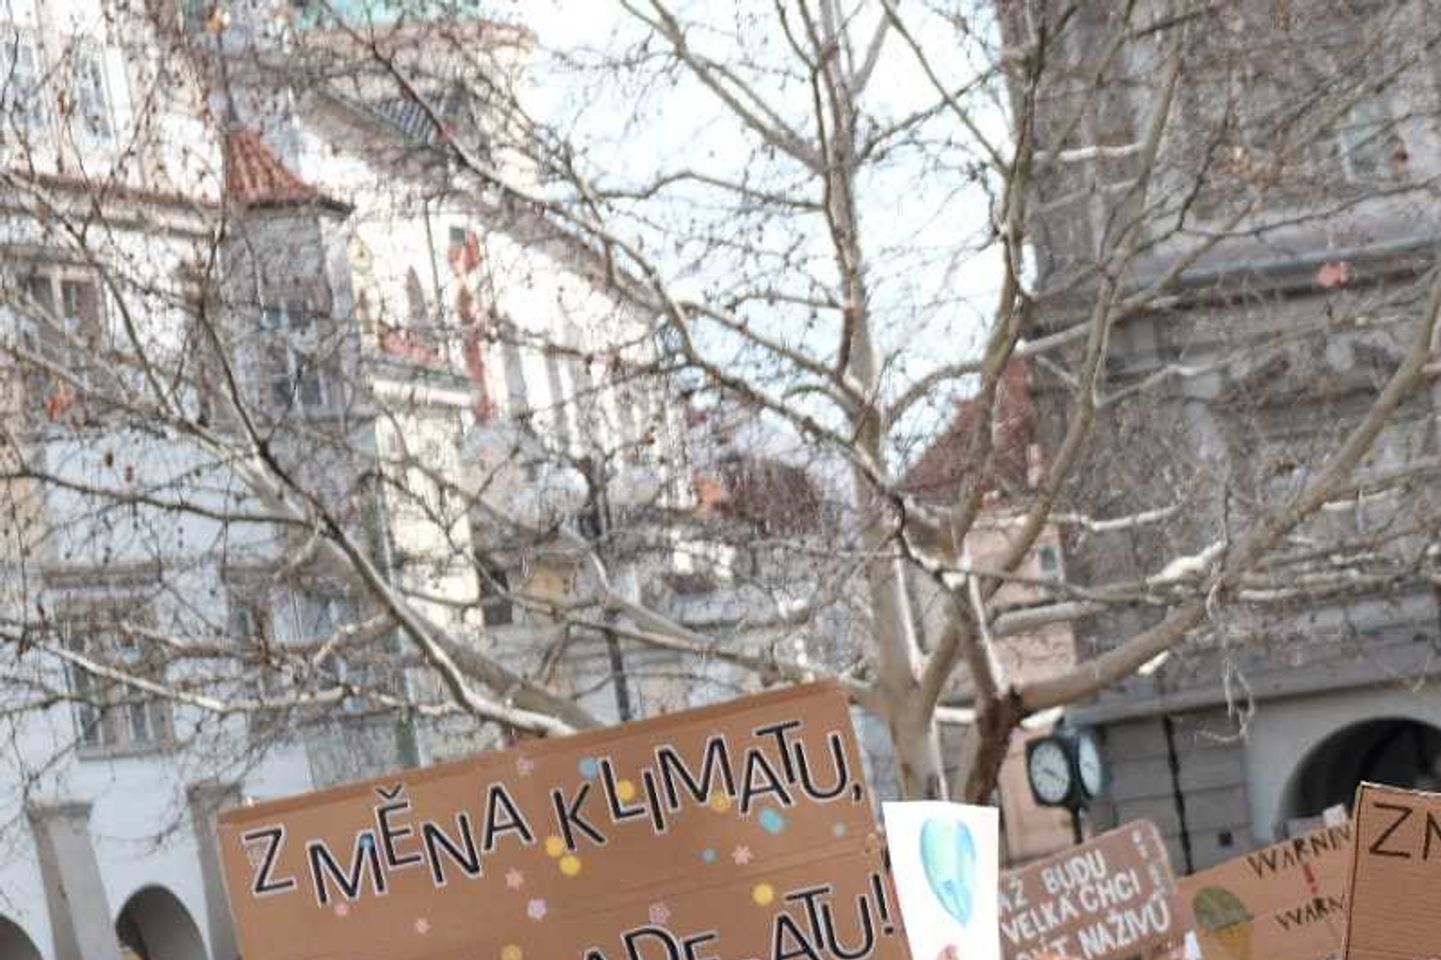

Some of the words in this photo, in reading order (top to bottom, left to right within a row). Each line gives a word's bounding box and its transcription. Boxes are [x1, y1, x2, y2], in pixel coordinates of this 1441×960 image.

[243, 783, 533, 907] ZMĚNA
[553, 719, 863, 852] KLIMATU,
[1041, 849, 1108, 894] BUDU
[1248, 826, 1350, 879] WARNIN
[1078, 869, 1142, 912] CHCI
[1275, 894, 1345, 931] WARN
